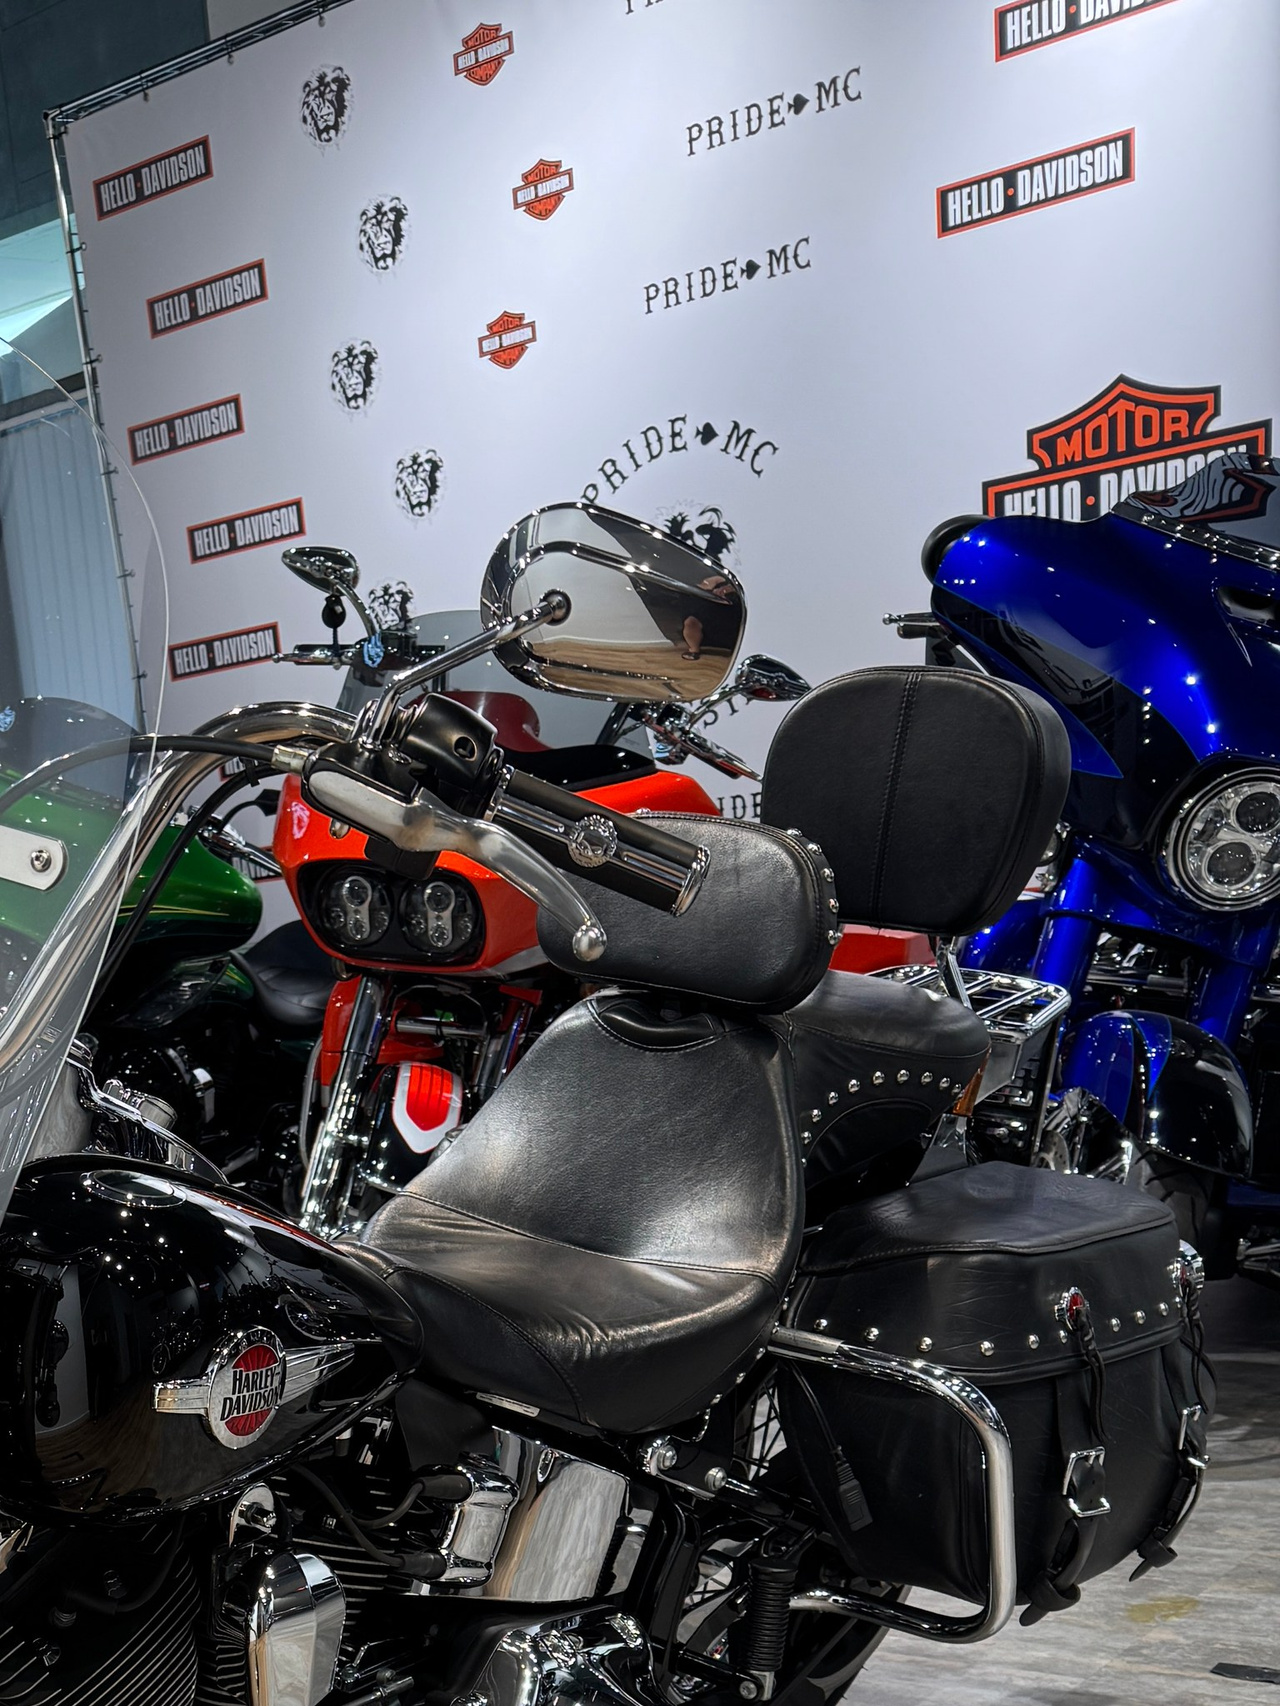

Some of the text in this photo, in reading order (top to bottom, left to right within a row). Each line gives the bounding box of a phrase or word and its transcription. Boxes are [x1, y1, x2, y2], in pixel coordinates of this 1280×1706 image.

[1006, 0, 1065, 50] HELLO
[686, 66, 862, 157] PRIDE MC
[100, 145, 206, 212] HELLO DAVIDSON
[947, 140, 1124, 228] HELLO DAVIDSON
[153, 268, 261, 331] HELLO DAVIDSON
[644, 235, 811, 315] PRIDE MC
[134, 402, 238, 458] HELLO DAVIDSON
[580, 413, 780, 503] PRIDE MC
[1056, 398, 1189, 466] MOTOR
[193, 505, 300, 557] HELLO DAVIDSON
[174, 629, 276, 675] HELLO DAVIDSON
[717, 792, 761, 820] IDE
[221, 1386, 280, 1421] DAVIDSON
[232, 1366, 281, 1395] HARLEY-
